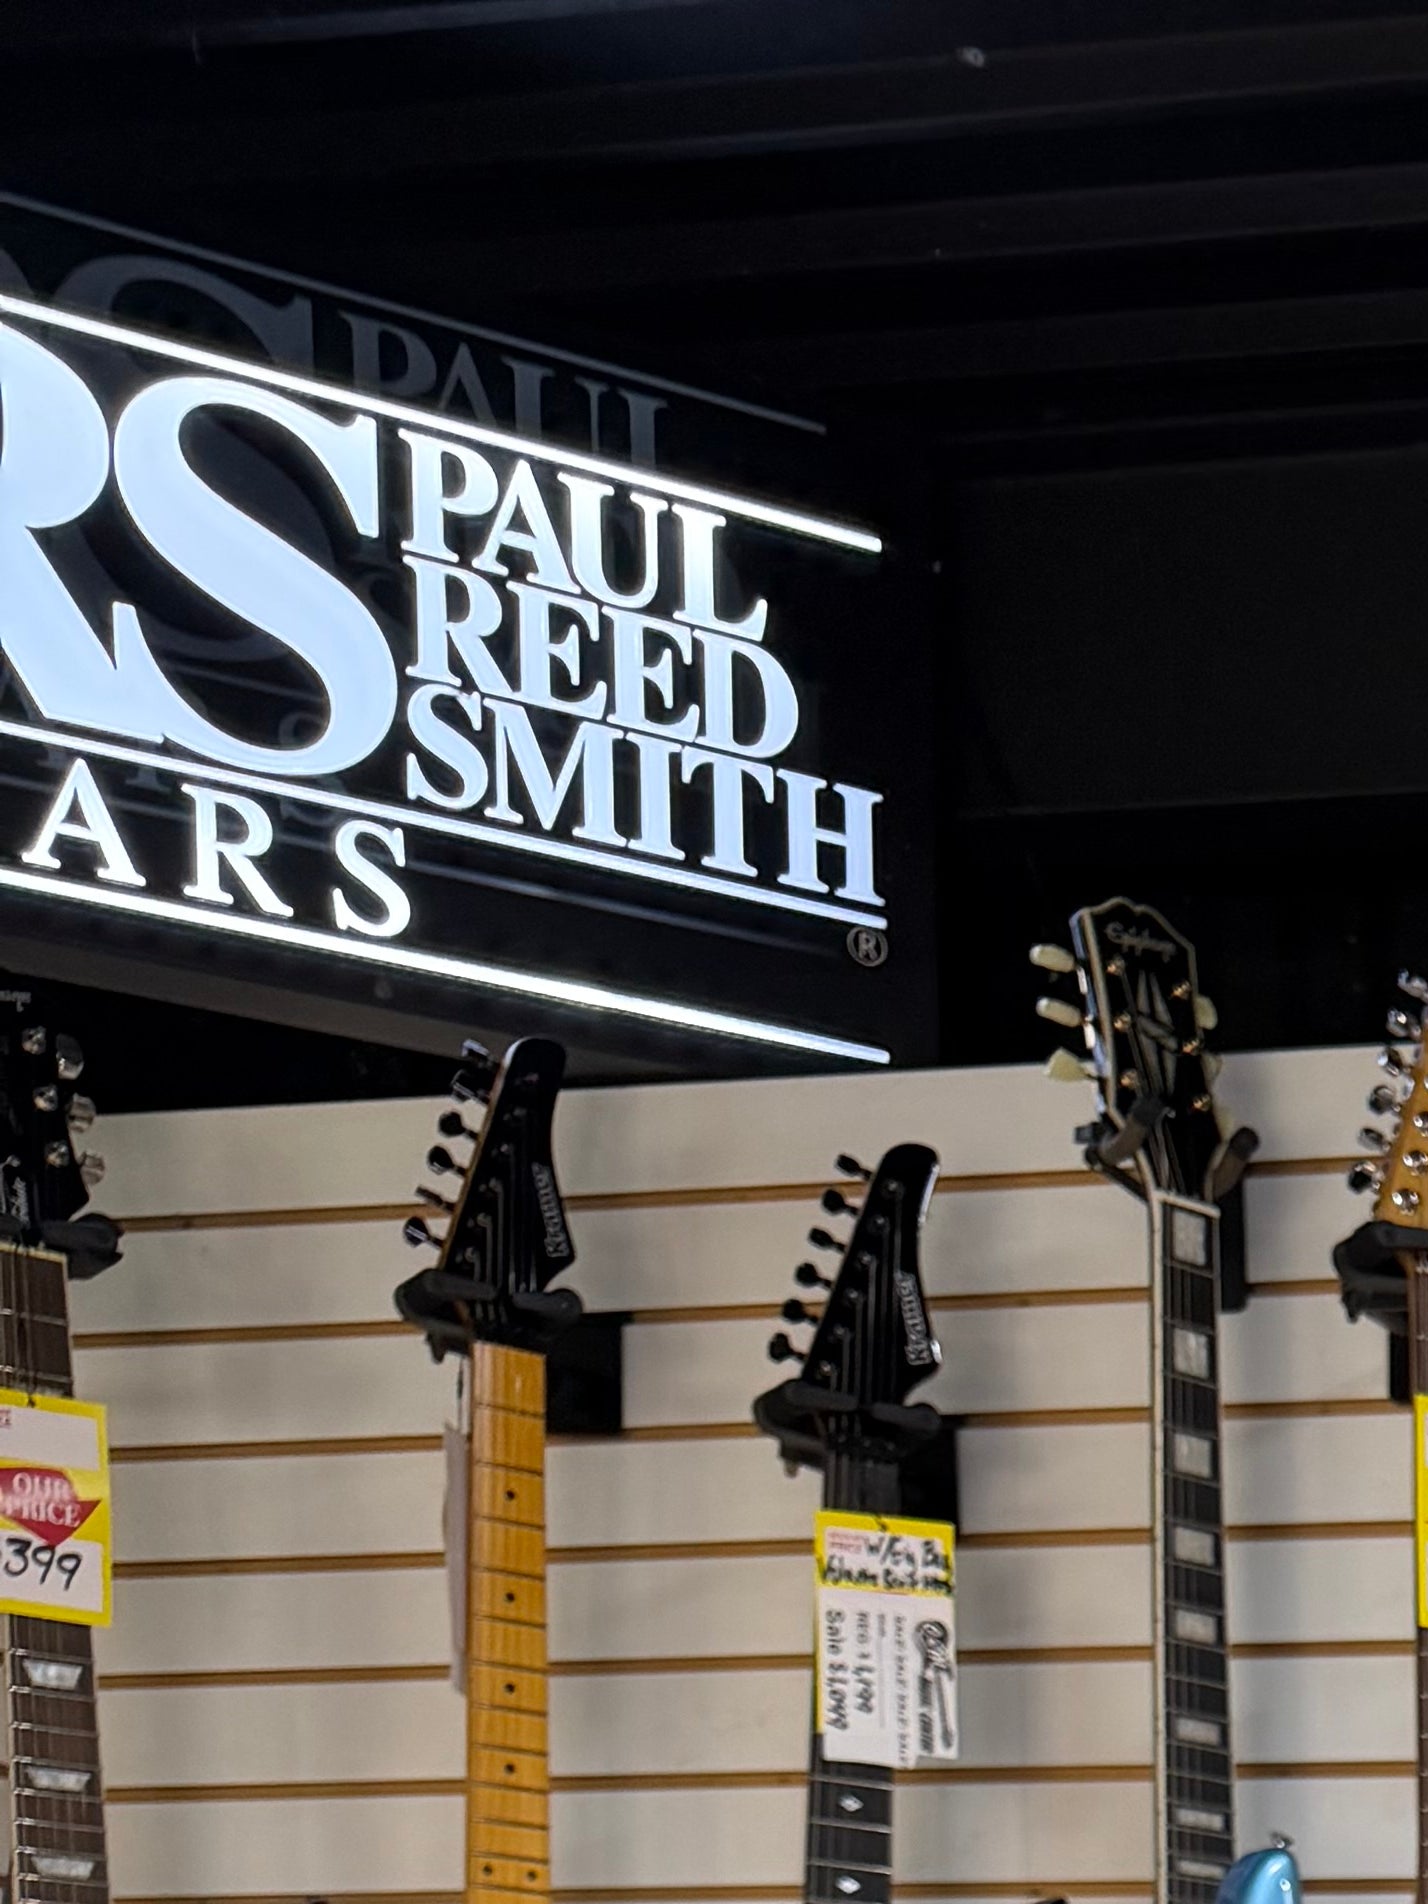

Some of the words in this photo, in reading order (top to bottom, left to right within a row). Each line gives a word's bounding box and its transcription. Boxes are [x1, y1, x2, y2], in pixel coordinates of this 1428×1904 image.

[397, 426, 769, 642] PAUL
[401, 554, 800, 760] REED
[21, 758, 411, 937] ARS
[405, 683, 887, 907] SMITH
[3, 1495, 82, 1528] PRICE
[12, 1470, 72, 1502] OUR
[3, 1537, 84, 1592] 399
[826, 1609, 846, 1656] Sale
